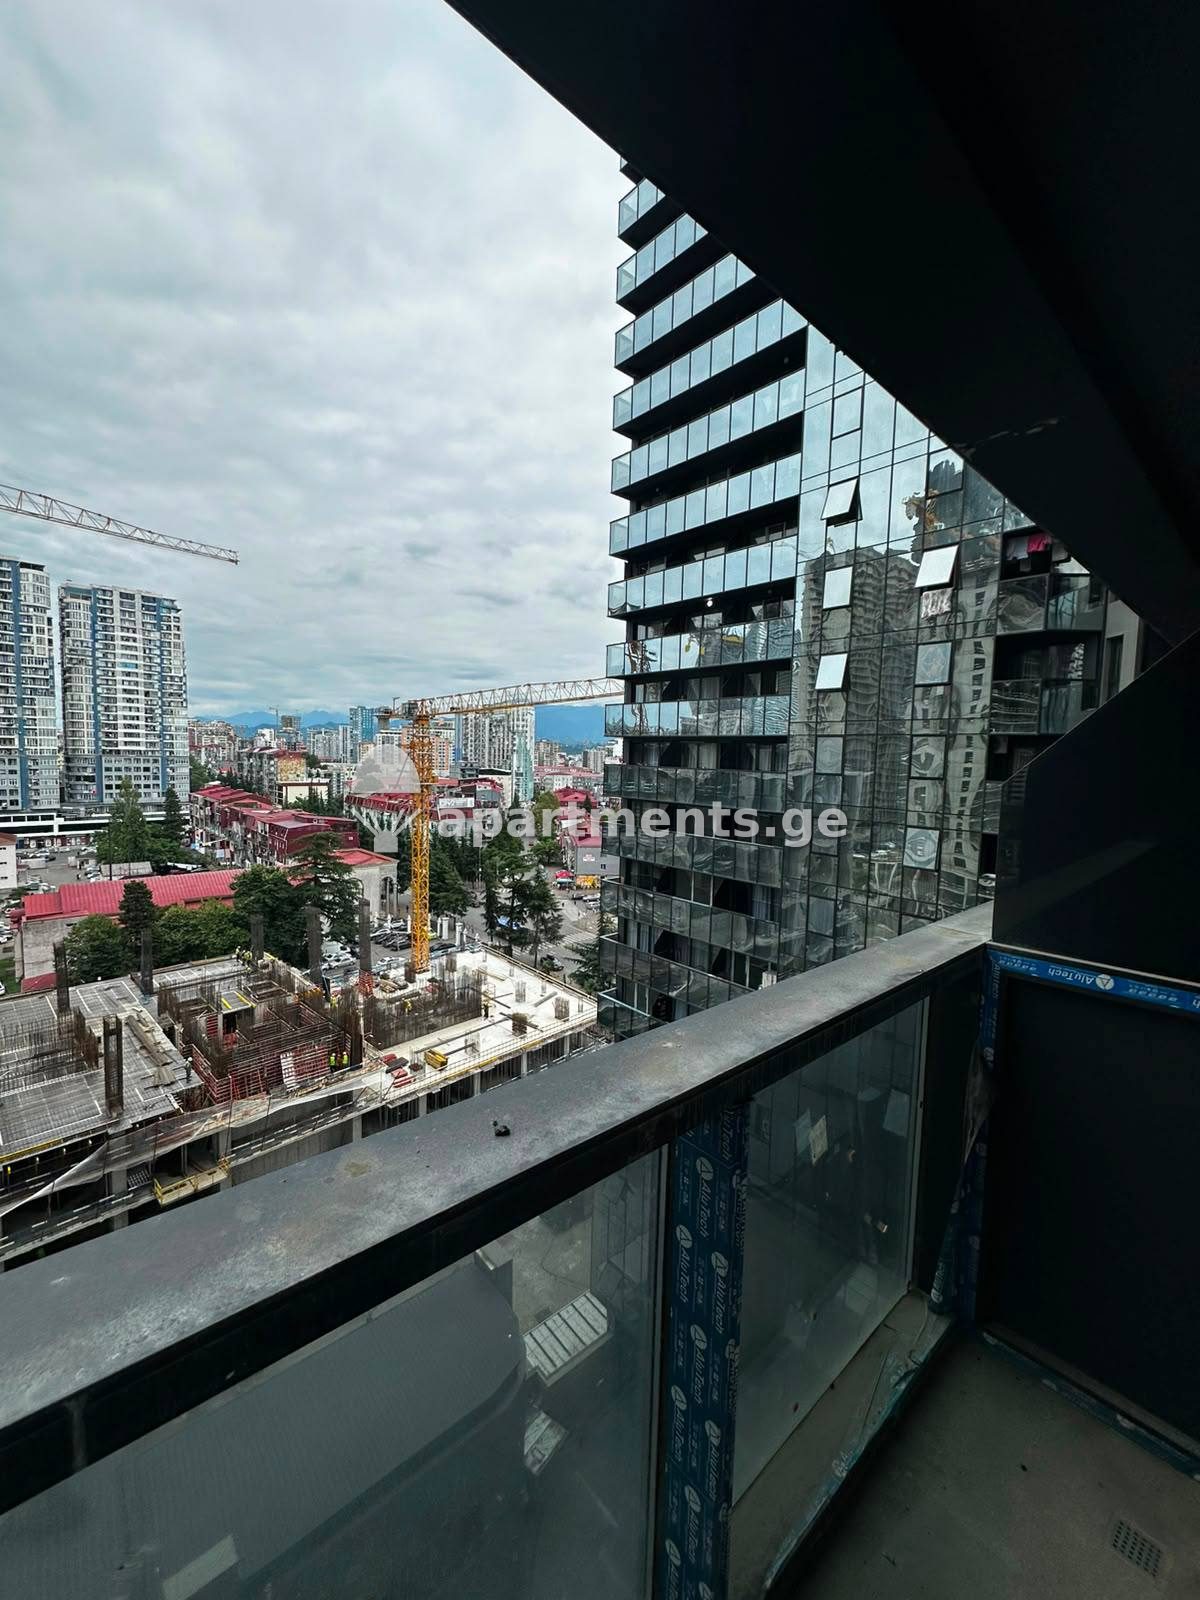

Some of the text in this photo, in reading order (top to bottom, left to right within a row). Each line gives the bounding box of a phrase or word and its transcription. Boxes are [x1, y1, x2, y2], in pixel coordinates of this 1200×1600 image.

[1047, 967, 1096, 985] AluTech
[699, 1180, 712, 1238] AluTech
[680, 1247, 690, 1303] AluTech
[715, 1275, 727, 1334] AluTech
[694, 1349, 705, 1408] AluTech
[674, 1407, 685, 1461] AluTech
[709, 1443, 720, 1501] AluTech
[689, 1510, 699, 1564] AluTech
